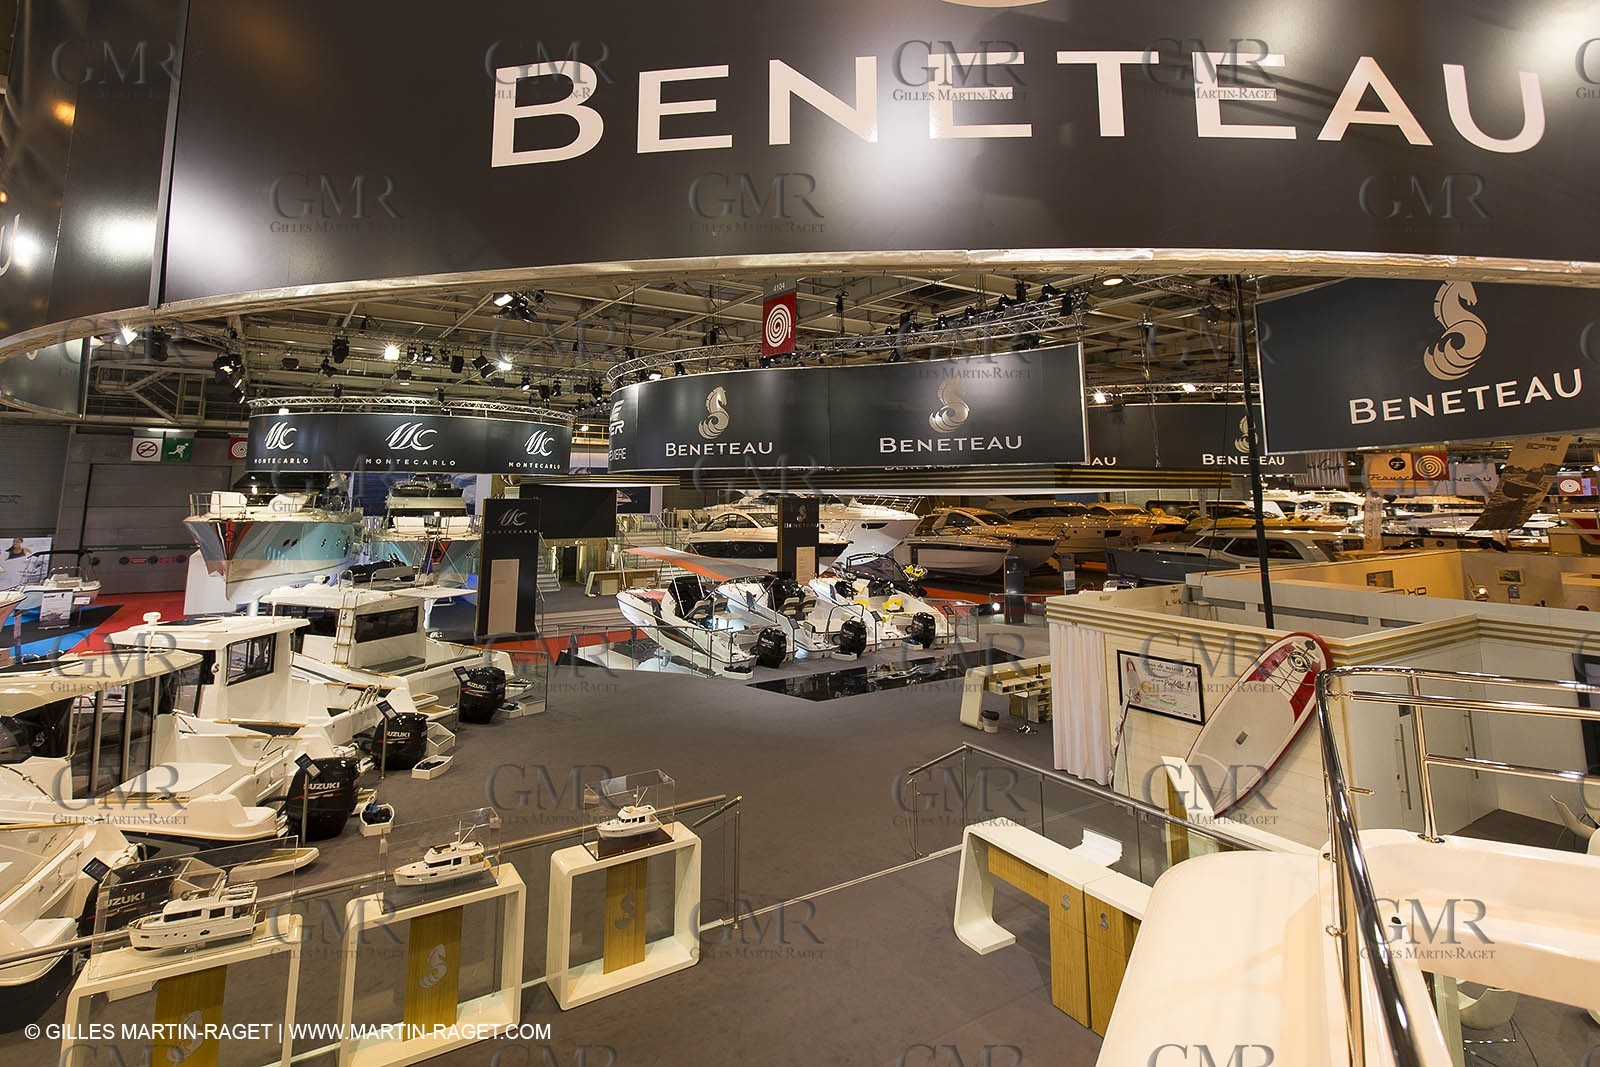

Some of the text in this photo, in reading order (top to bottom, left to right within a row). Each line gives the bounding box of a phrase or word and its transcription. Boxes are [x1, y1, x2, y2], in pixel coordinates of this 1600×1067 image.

[491, 51, 1547, 167] BENETEAU
[1350, 368, 1583, 424] BENETEAU
[665, 442, 773, 457] BENETEAU
[879, 436, 1023, 453] BENETEAU
[365, 458, 456, 466] MONTECARLO
[509, 462, 561, 470] MONTECARLO
[1202, 453, 1285, 465] BENEEAU
